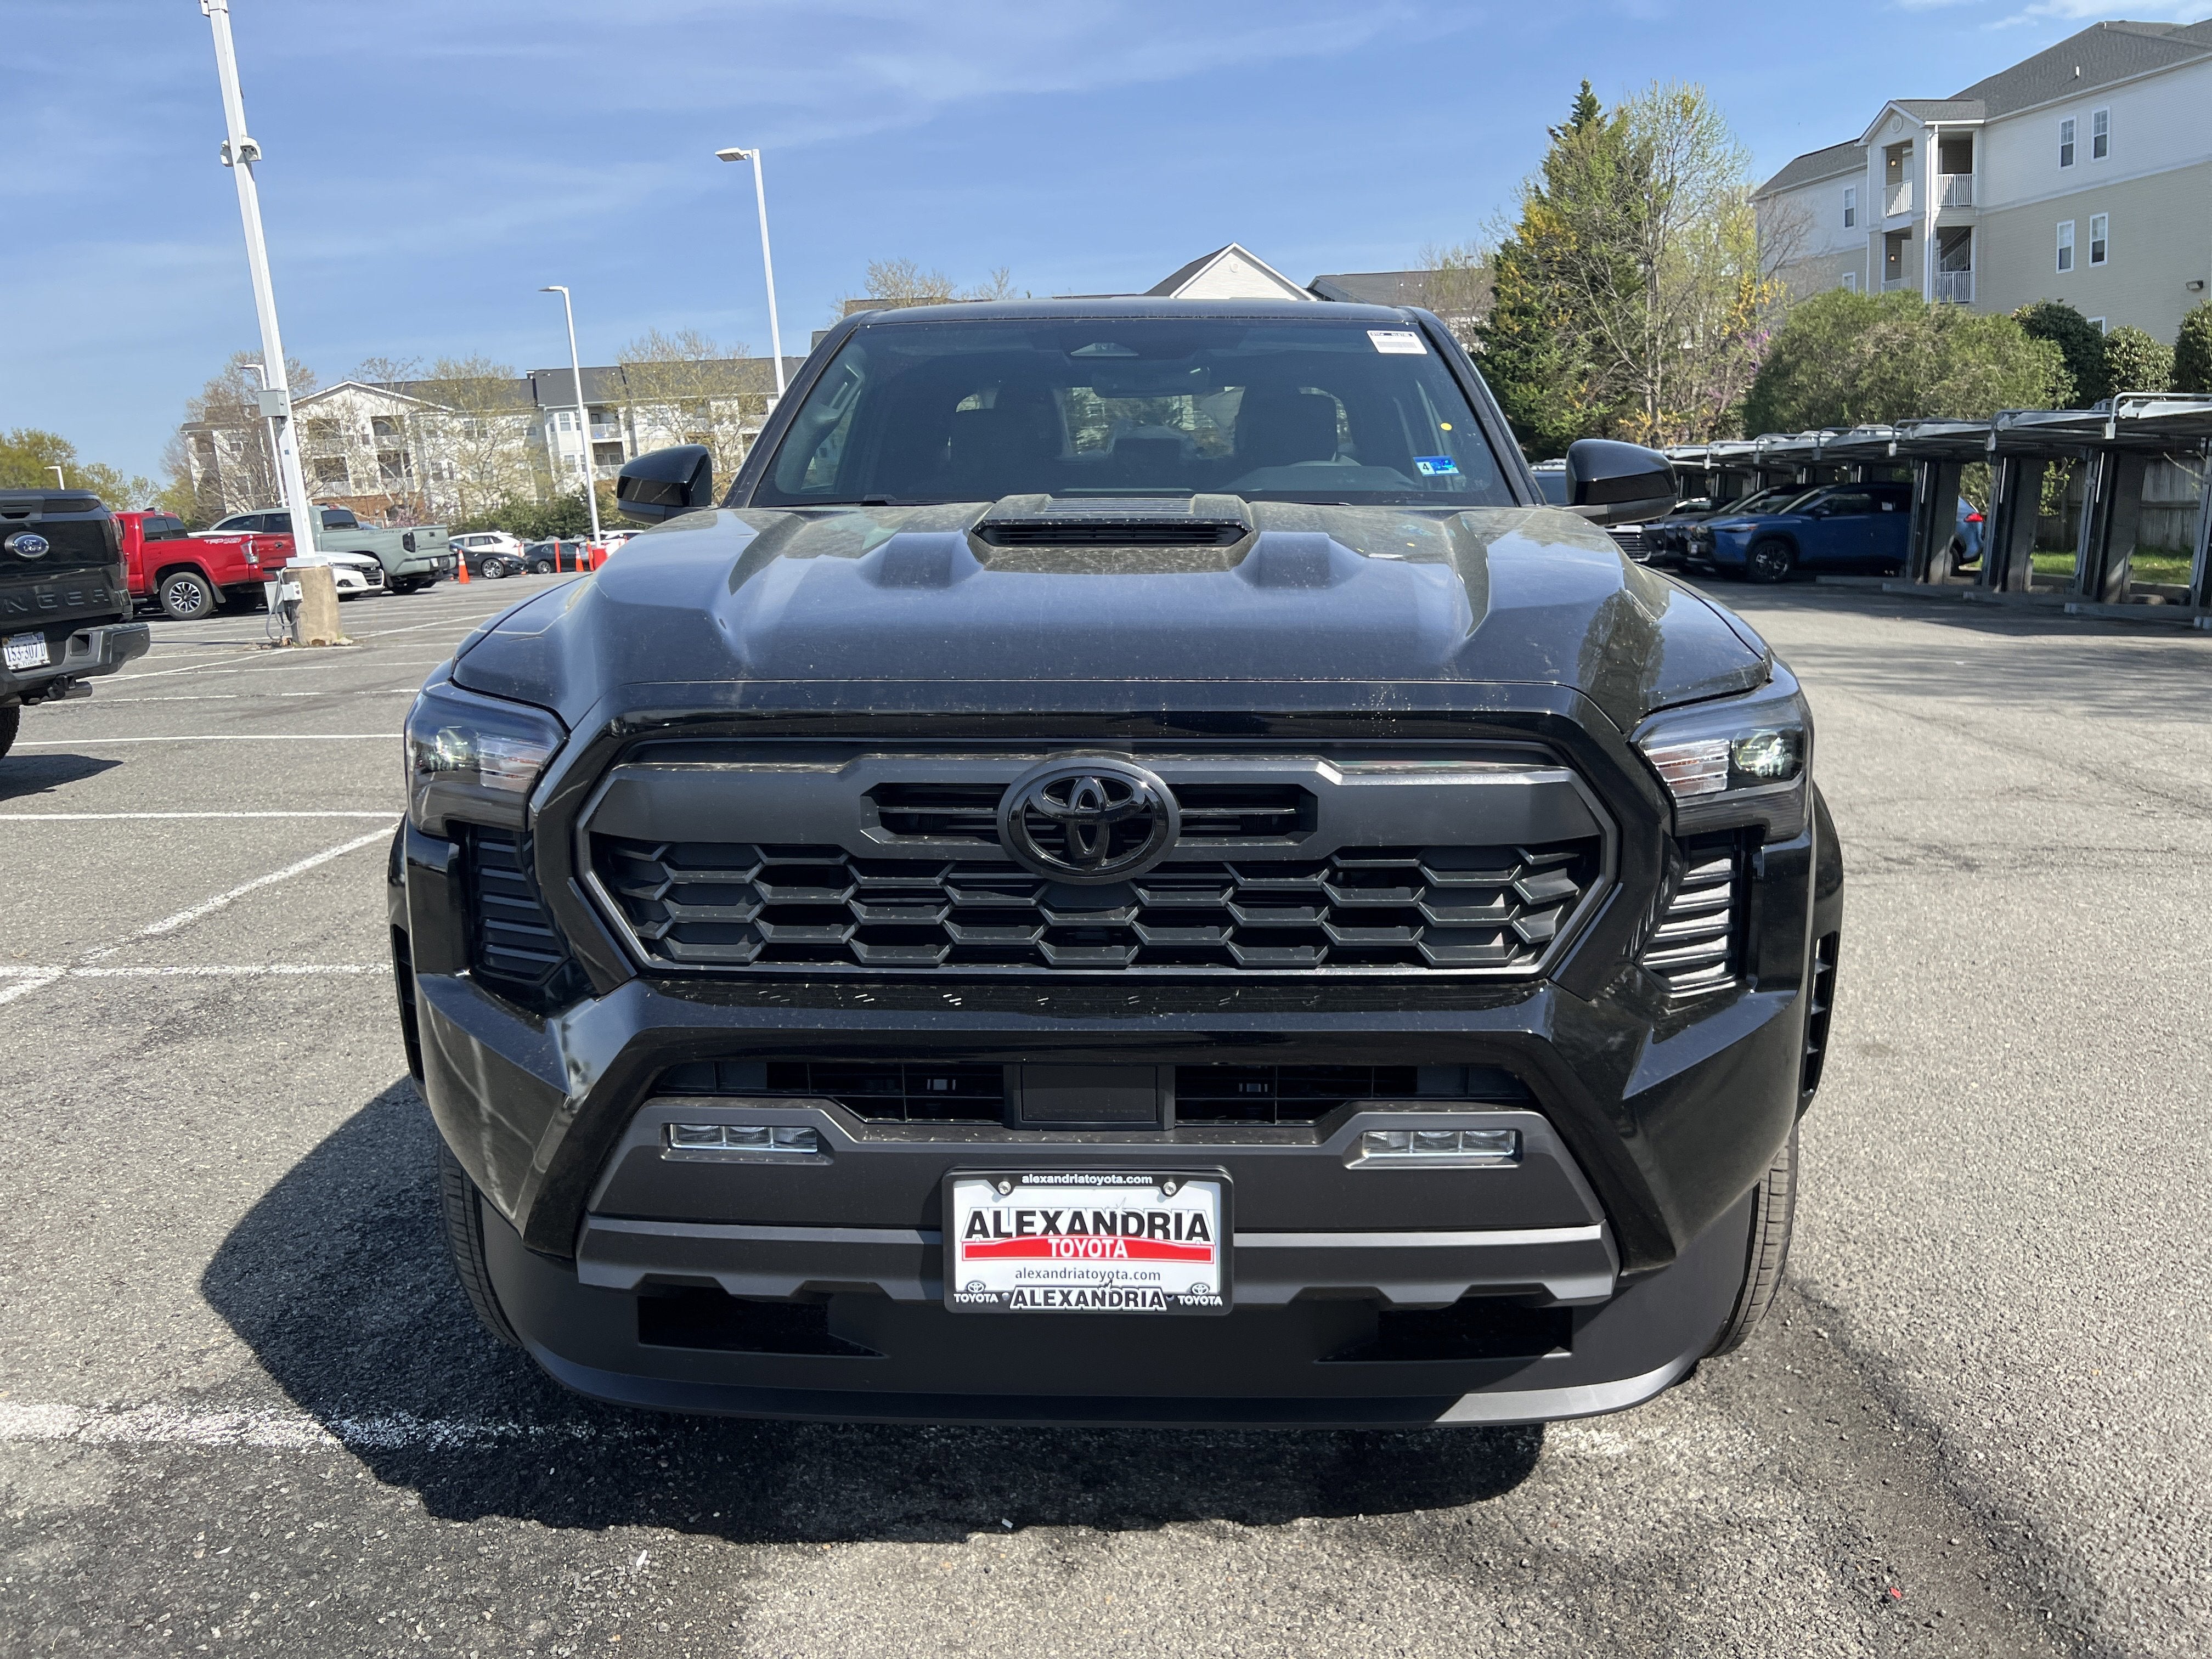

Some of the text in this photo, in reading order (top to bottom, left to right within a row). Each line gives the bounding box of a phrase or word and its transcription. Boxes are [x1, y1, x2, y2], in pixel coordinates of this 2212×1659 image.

[22, 539, 42, 552] Ford
[1021, 1173, 1153, 1186] alexandriatoyota.com
[964, 1209, 1212, 1242] ALEXANDRIA
[1048, 1238, 1128, 1258] TOYOTA
[1015, 1267, 1161, 1283] alexandriatoyota.com
[953, 1293, 999, 1305] TOYOTA
[1011, 1287, 1166, 1311] ALEXANDRIA
[1177, 1295, 1223, 1307] TOYOTA
